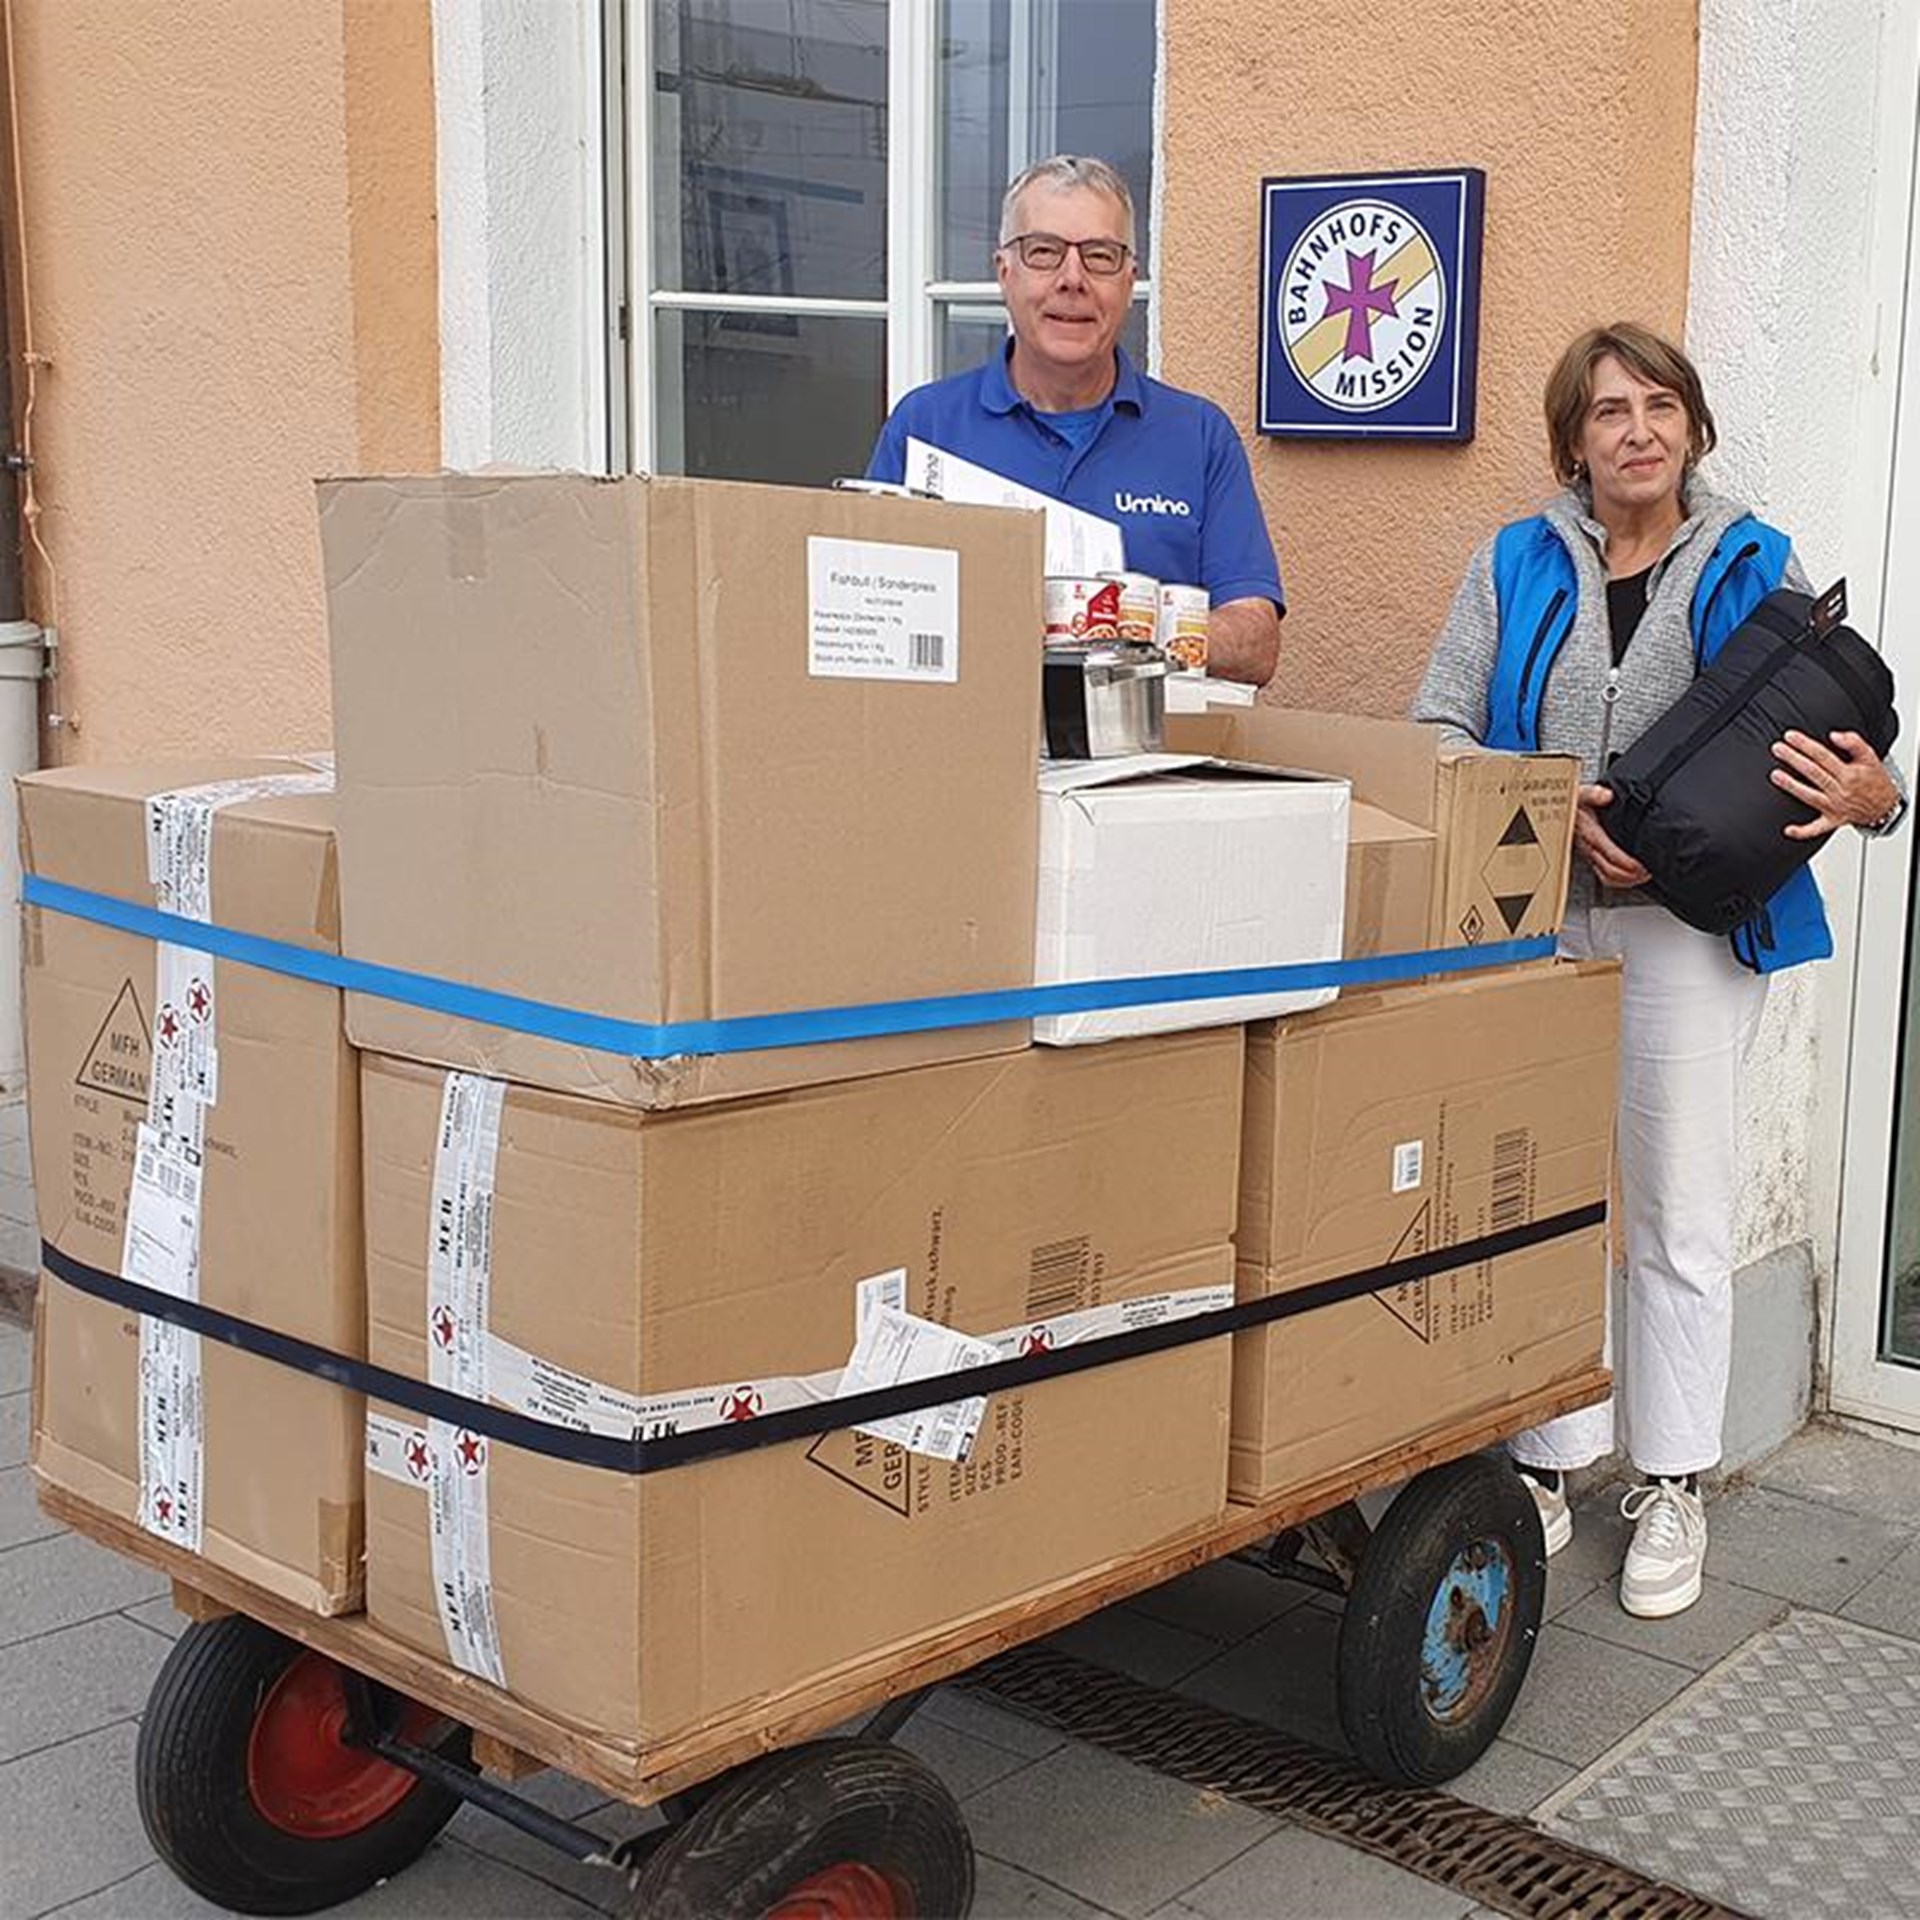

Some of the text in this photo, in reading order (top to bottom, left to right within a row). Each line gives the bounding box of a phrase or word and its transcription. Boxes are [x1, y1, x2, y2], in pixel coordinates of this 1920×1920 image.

[1288, 213, 1402, 325] BAHNHOFS
[1334, 306, 1434, 398] MISSION
[91, 1060, 151, 1094] GERMAN
[917, 1464, 931, 1513] STYLE
[965, 1460, 978, 1496] SIZE
[980, 1459, 992, 1491] PCS
